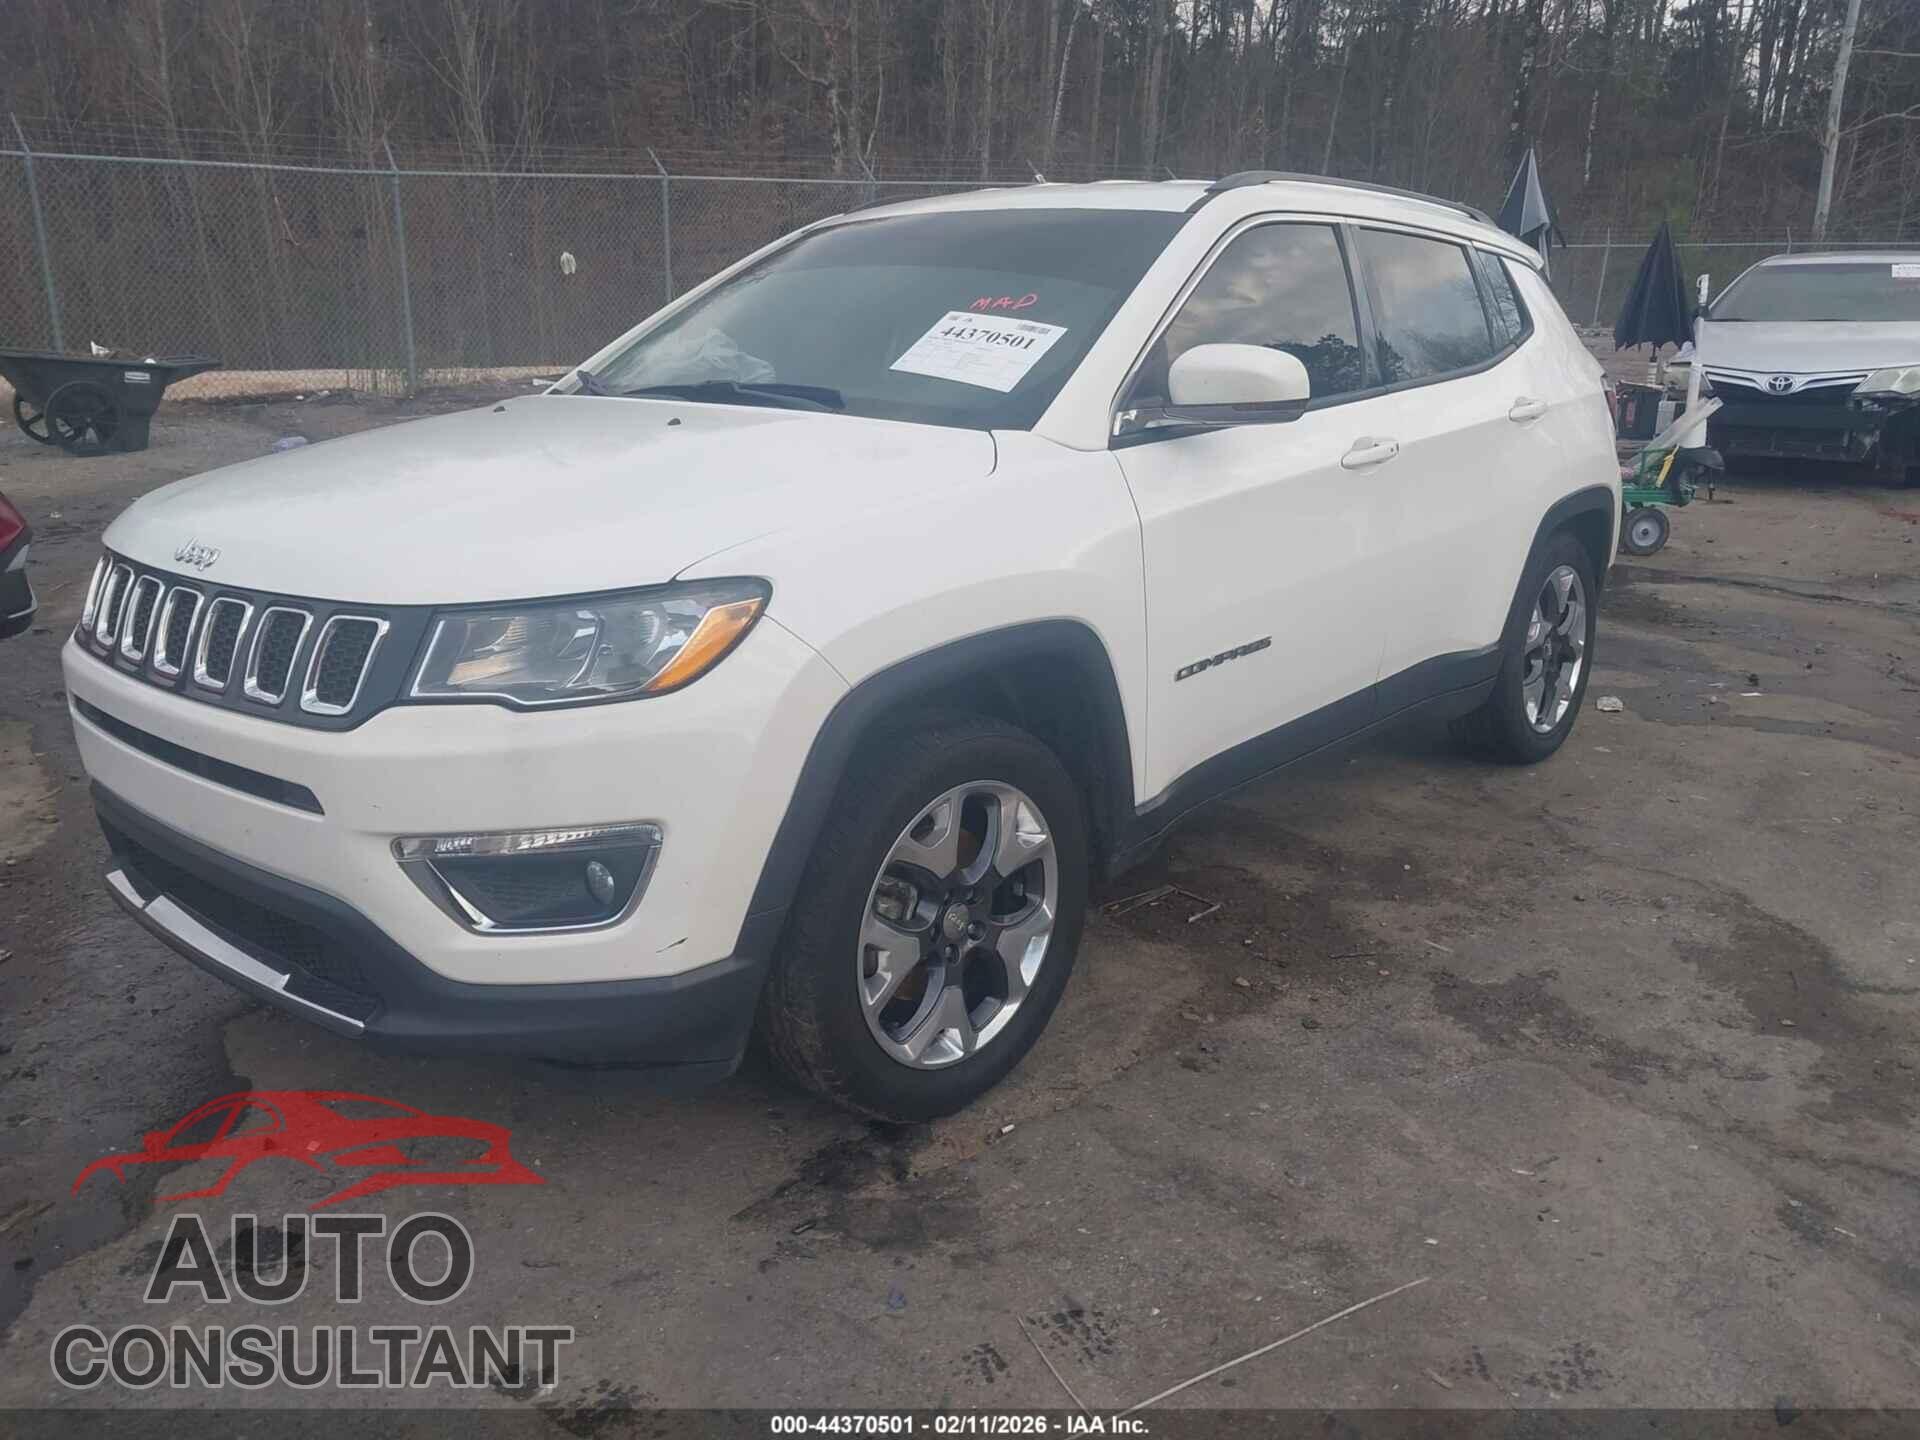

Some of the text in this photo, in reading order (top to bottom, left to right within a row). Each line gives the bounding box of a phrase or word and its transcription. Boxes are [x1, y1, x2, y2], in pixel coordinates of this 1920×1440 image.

[968, 293, 1038, 311] MAD
[941, 326, 1037, 350] 44370501
[175, 536, 221, 571] Jeep
[1175, 636, 1272, 681] COMPASS
